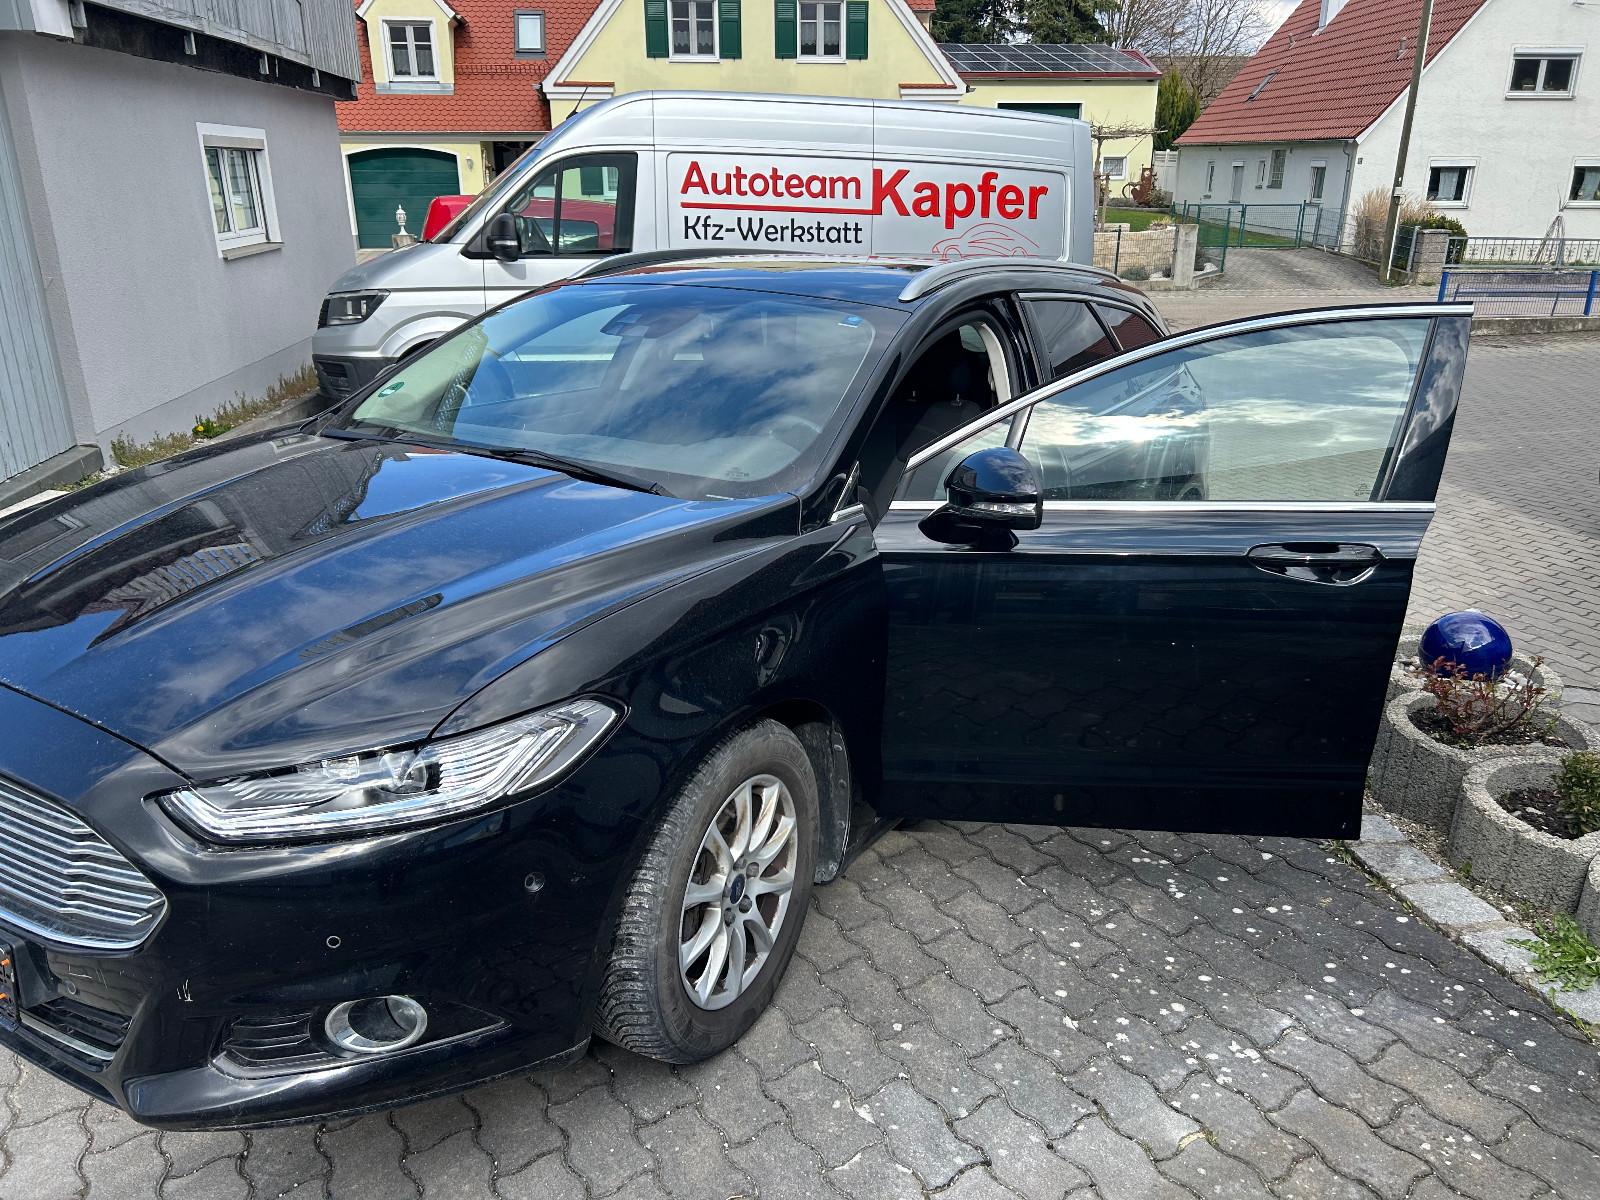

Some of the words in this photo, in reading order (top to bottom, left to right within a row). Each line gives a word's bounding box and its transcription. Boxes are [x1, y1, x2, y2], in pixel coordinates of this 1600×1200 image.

[680, 161, 861, 200] Autoteam
[872, 168, 1049, 229] Kapfer
[683, 215, 863, 244] Kfz-Werkstatt
